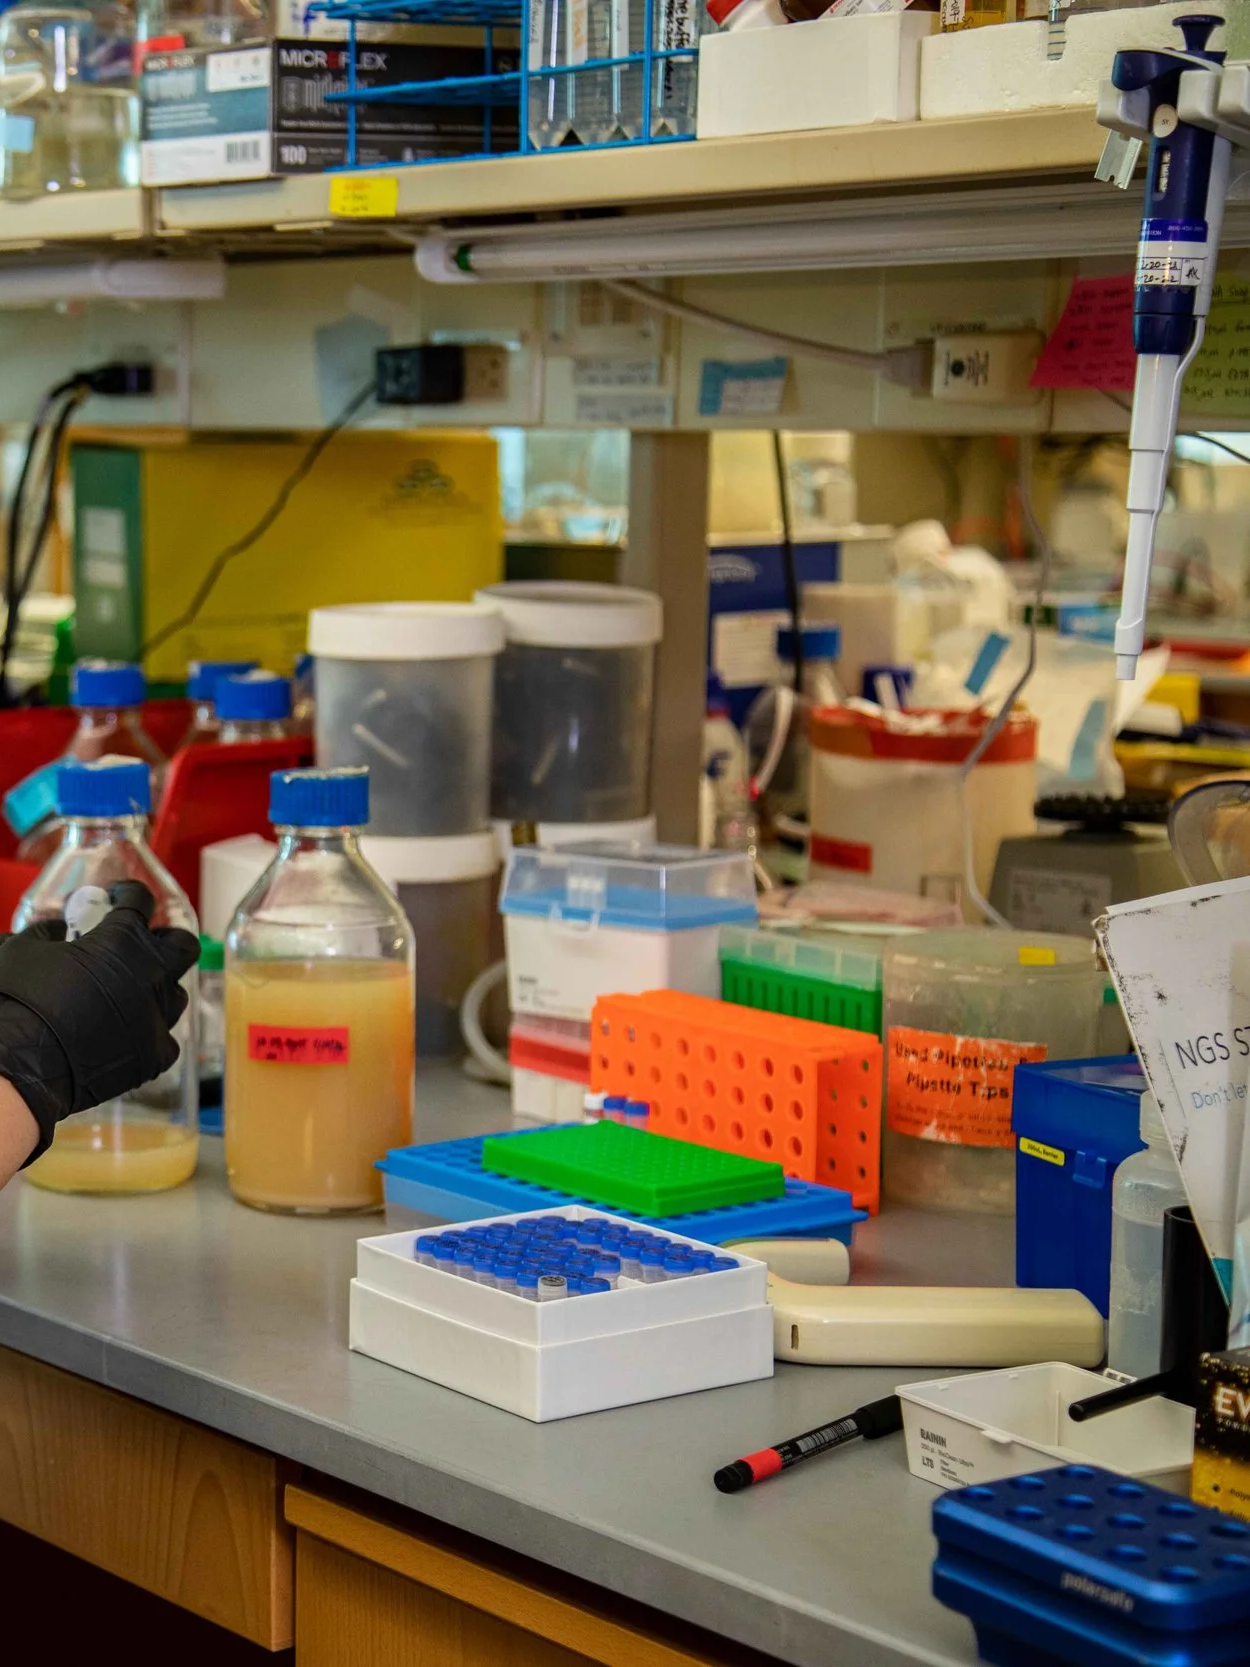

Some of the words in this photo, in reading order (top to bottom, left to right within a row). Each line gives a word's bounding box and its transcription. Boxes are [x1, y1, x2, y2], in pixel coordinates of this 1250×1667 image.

[280, 49, 388, 71] MICROFEX
[1174, 1032, 1230, 1069] NGS
[1191, 1086, 1230, 1109] Don't
[920, 1428, 947, 1448] RAININ
[922, 1456, 934, 1469] LTS
